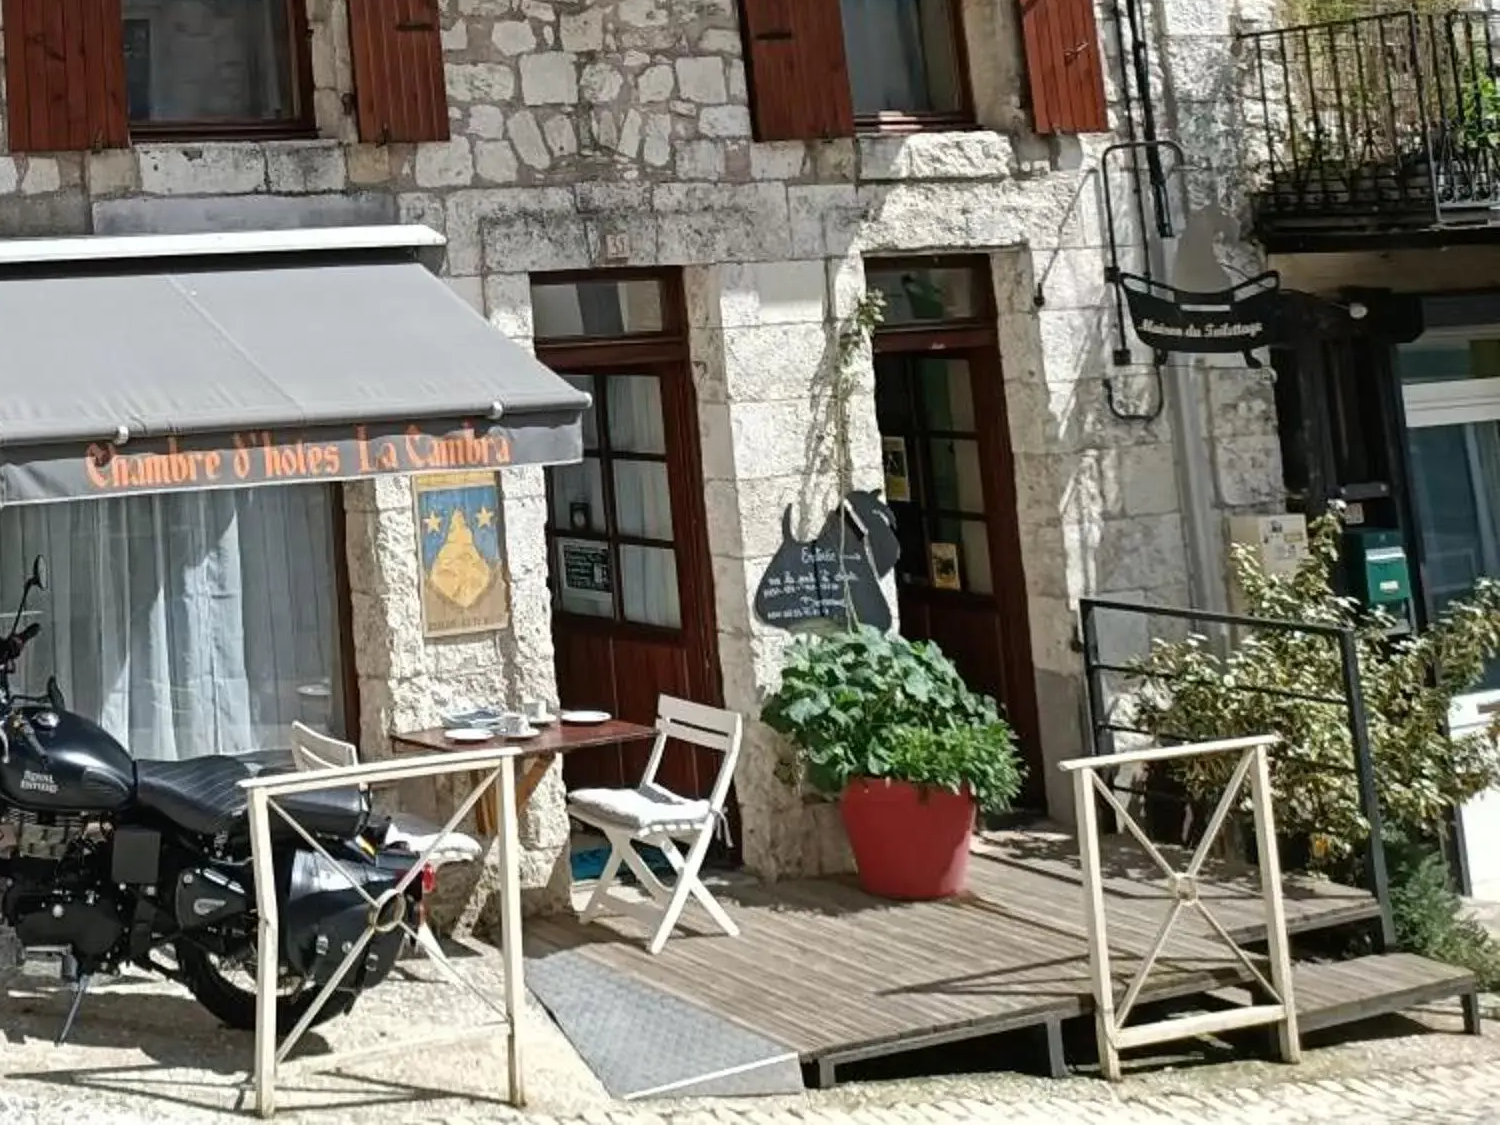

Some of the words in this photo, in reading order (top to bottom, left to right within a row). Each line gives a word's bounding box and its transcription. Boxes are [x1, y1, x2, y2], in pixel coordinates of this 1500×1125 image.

[1185, 324, 1202, 337] du
[85, 436, 222, 488] Chambre
[355, 423, 399, 473] La
[405, 420, 511, 468] Cambra
